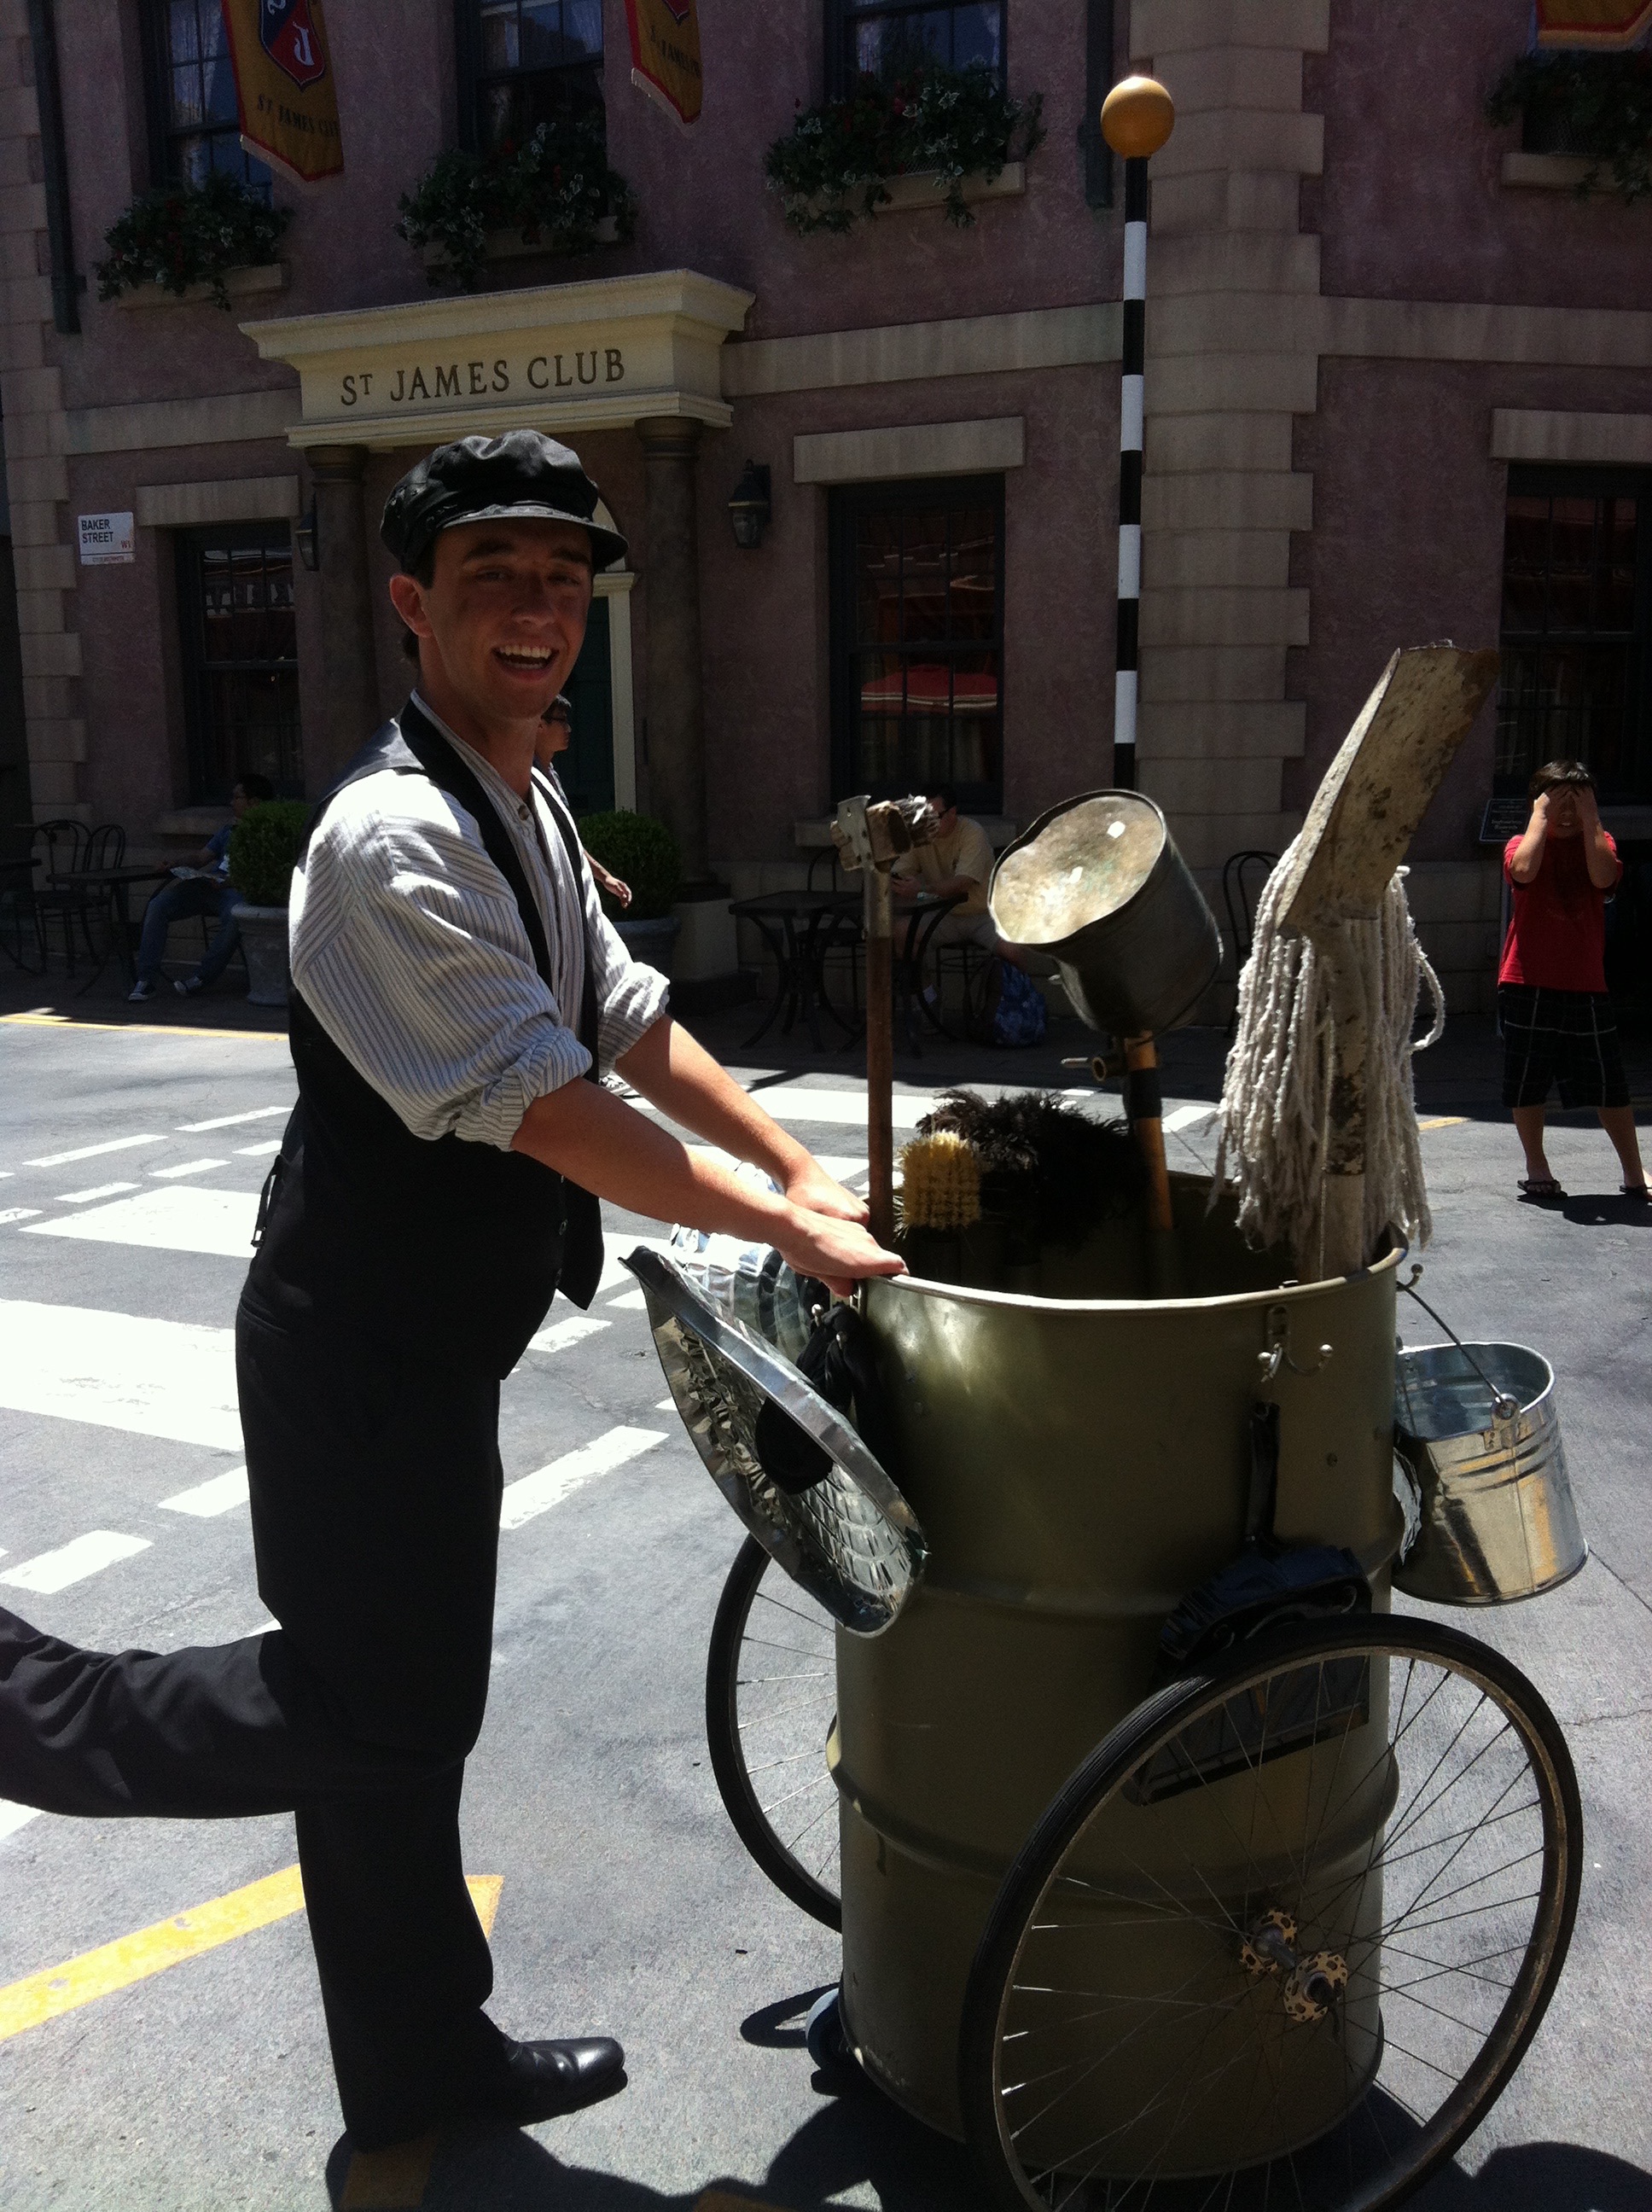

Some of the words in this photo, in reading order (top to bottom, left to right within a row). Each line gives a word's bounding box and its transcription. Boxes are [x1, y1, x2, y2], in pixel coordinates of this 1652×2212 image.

[278, 103, 316, 135] JAMES
[340, 373, 373, 406] ST
[389, 359, 510, 402] JAMES
[526, 348, 625, 389] CLUB
[81, 519, 111, 531] BAKER
[82, 531, 114, 544] STREET
